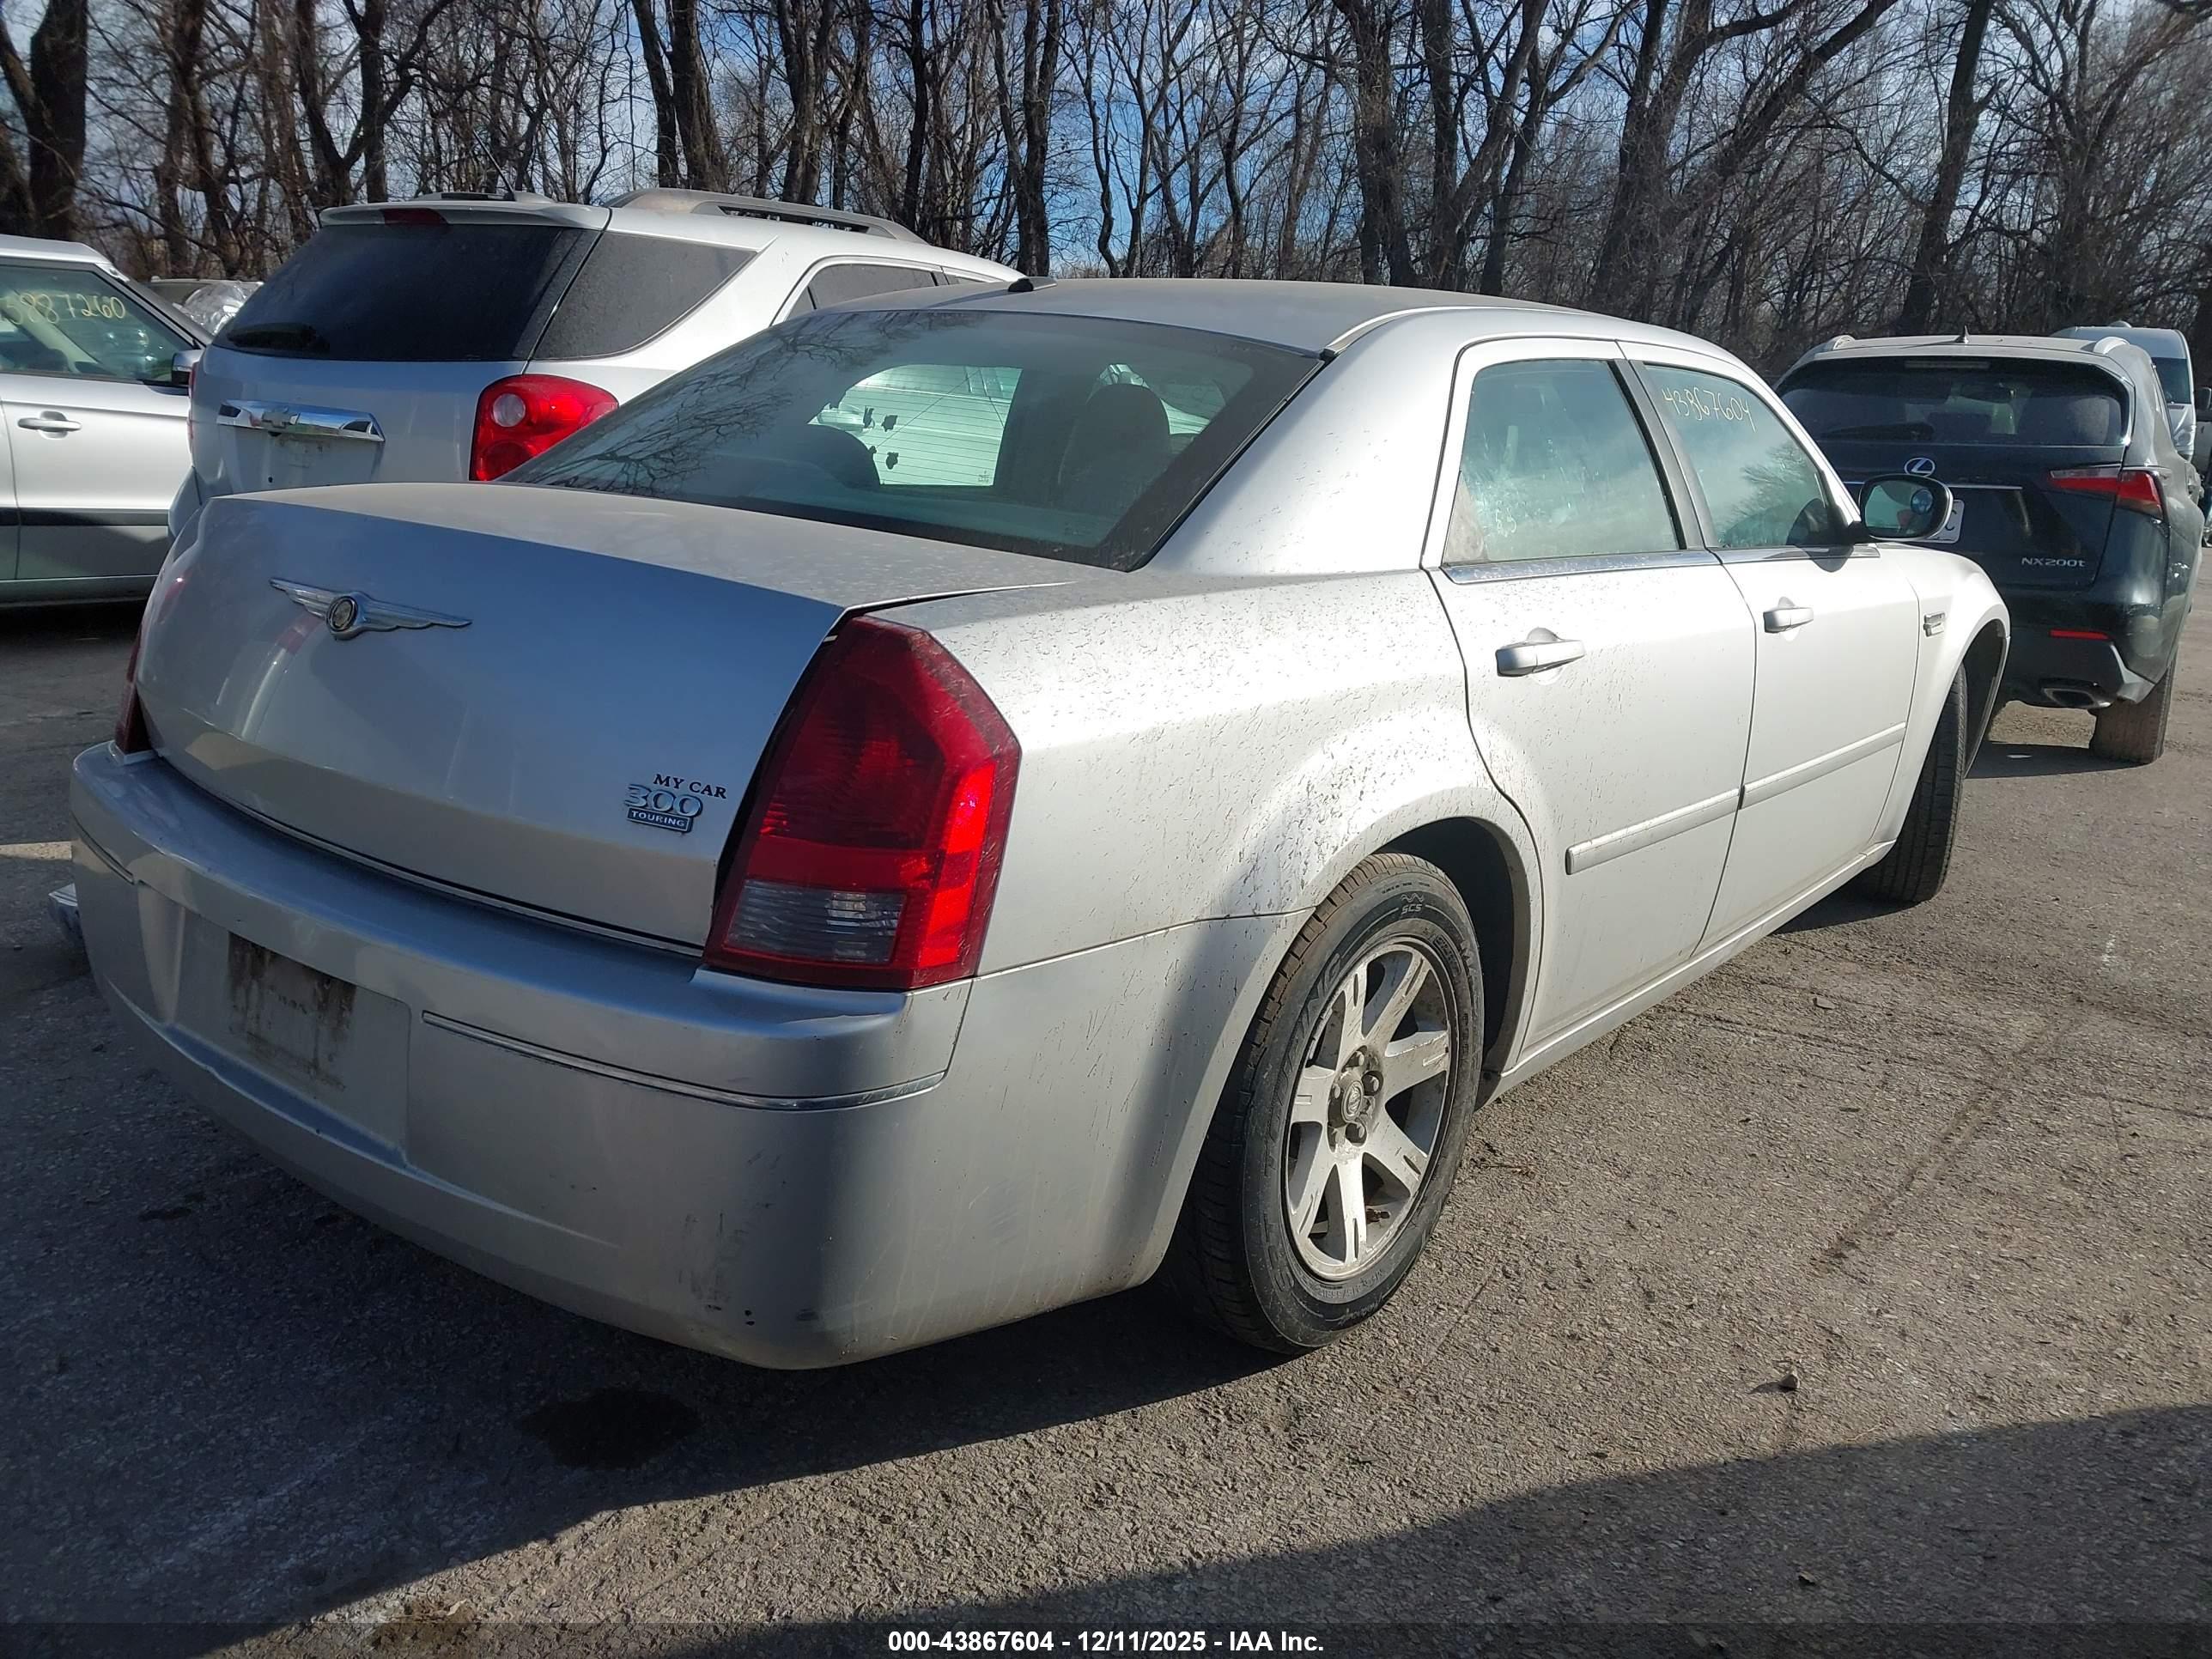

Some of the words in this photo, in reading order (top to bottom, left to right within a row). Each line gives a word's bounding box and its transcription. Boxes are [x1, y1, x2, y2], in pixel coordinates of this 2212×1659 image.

[1662, 387, 1756, 432] 43867604
[2021, 556, 2086, 568] NX200t
[653, 773, 685, 789] MY
[689, 782, 727, 799] CAR
[624, 784, 703, 817] 300
[631, 810, 685, 827] TOURING
